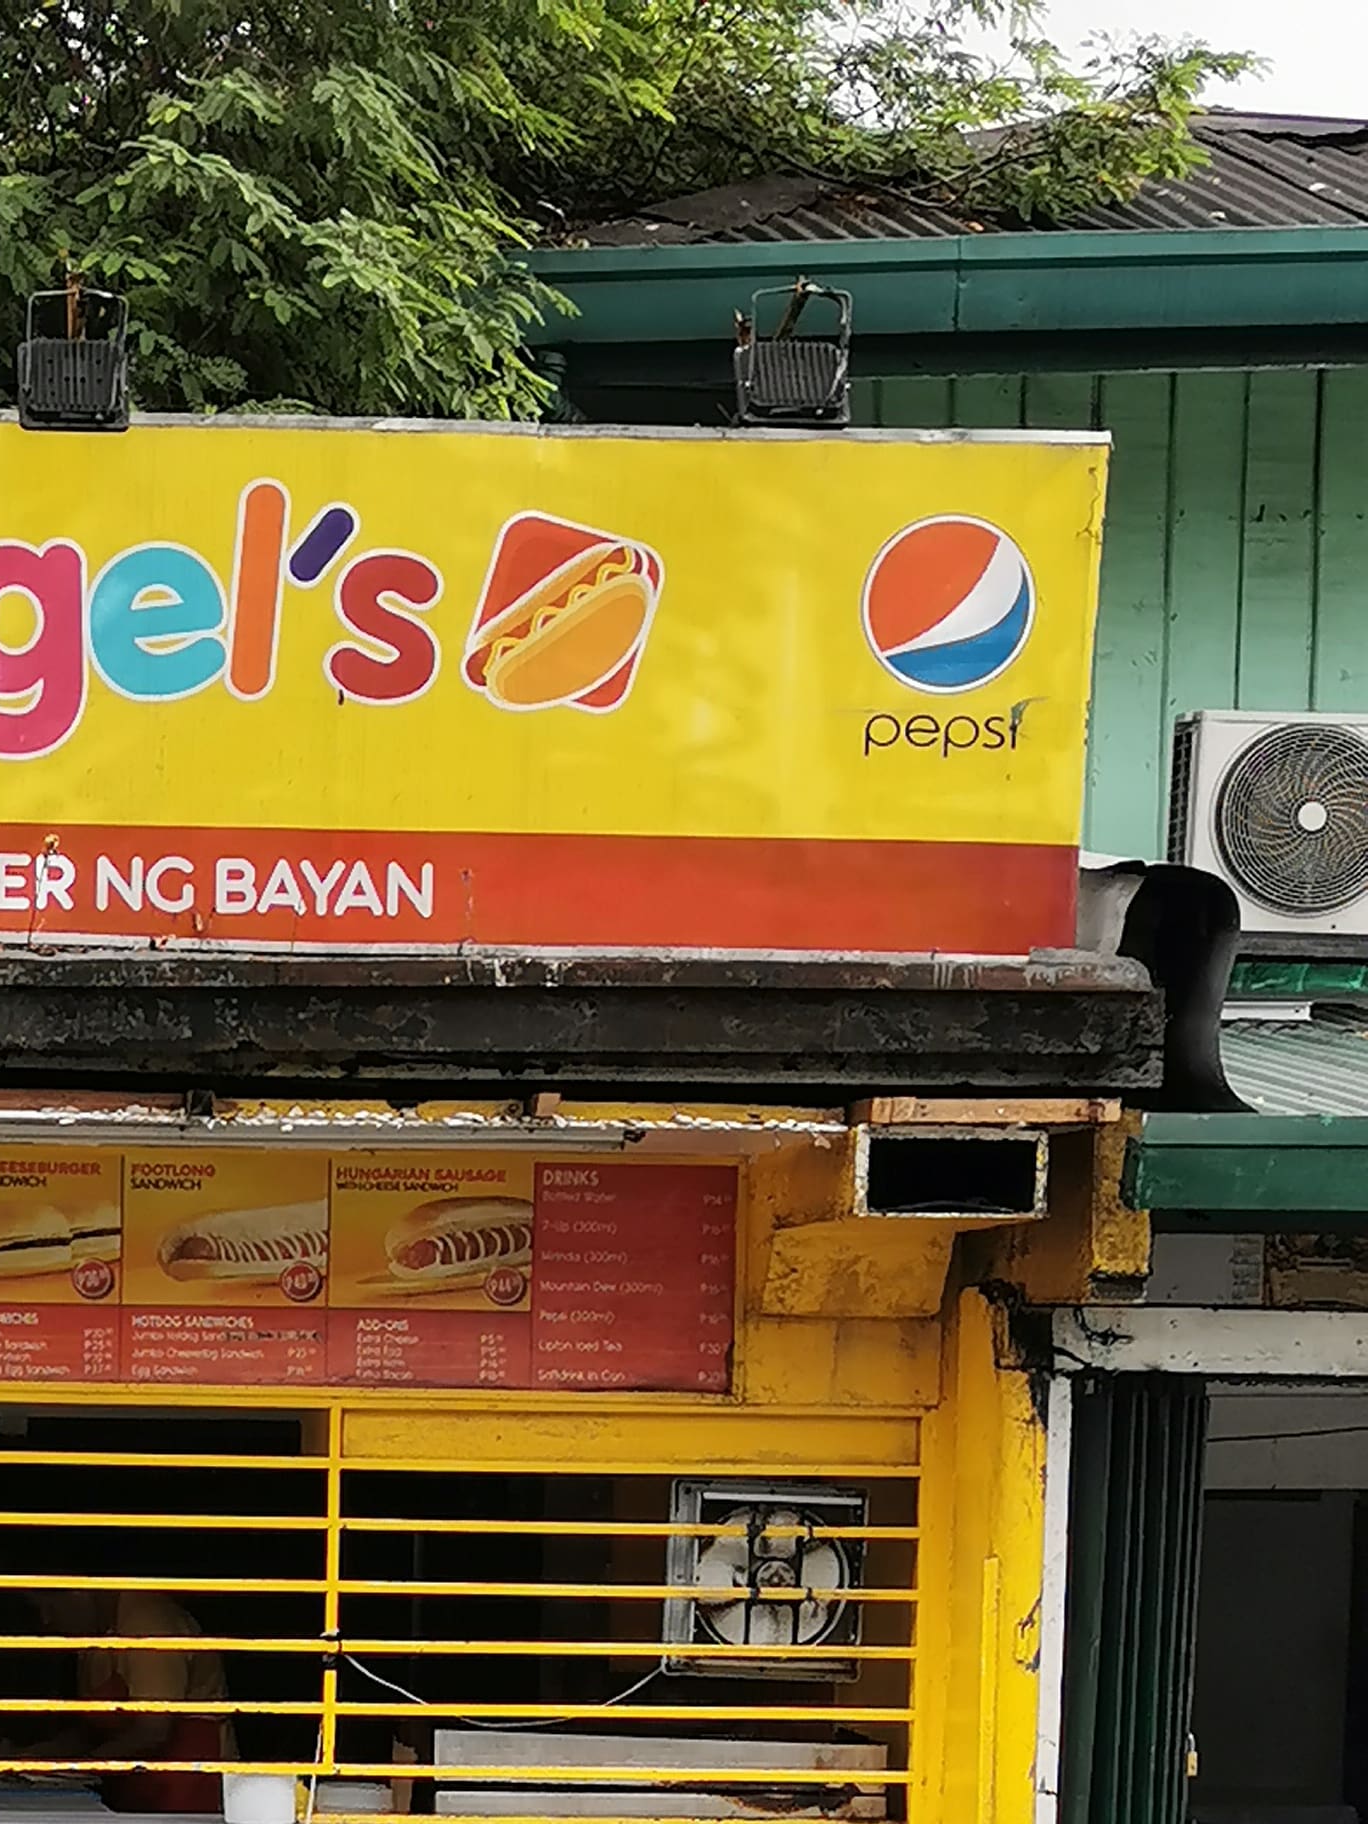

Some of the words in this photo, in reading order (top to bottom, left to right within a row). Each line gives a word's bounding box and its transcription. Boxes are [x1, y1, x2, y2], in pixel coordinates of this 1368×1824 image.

[864, 707, 1020, 758] pepsi
[97, 854, 194, 914] NG
[214, 858, 434, 919] BAYAN
[131, 1164, 216, 1178] FOOTLONG
[335, 1166, 429, 1182] HUNGARIAN
[433, 1168, 507, 1183] SAUSAGE
[542, 1169, 600, 1186] DRINKS
[130, 1178, 202, 1191] SANDWICH
